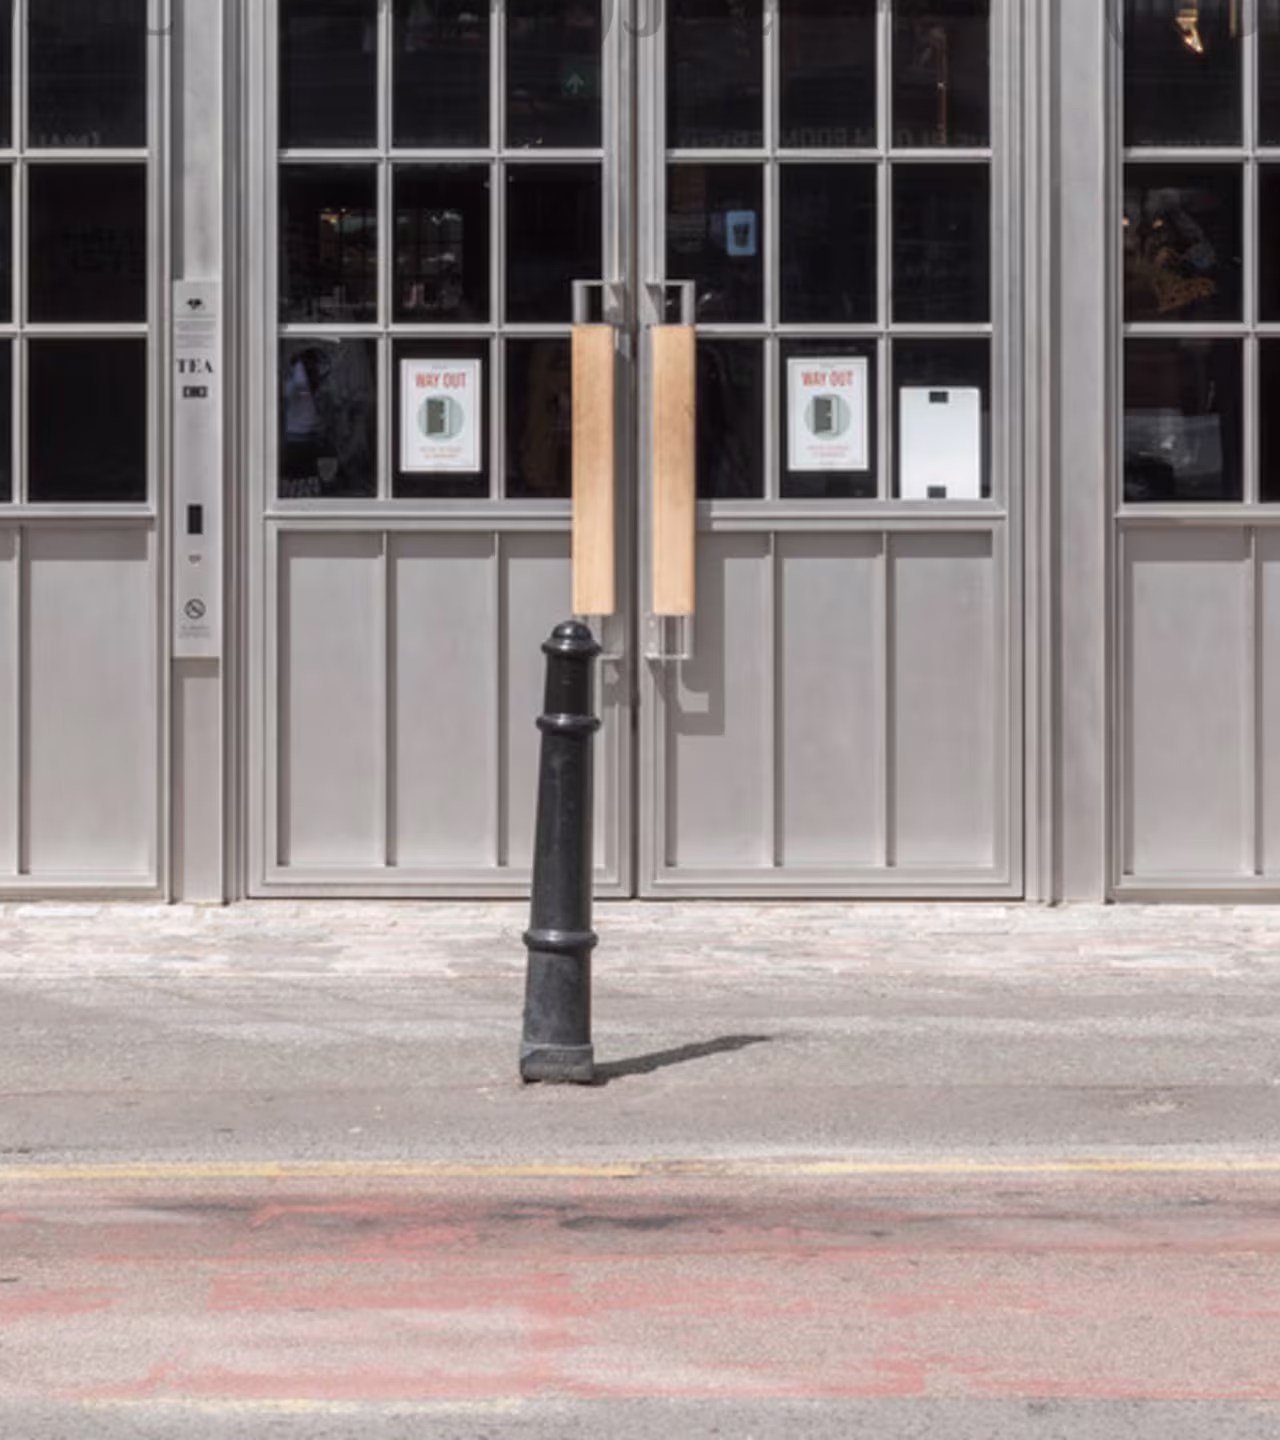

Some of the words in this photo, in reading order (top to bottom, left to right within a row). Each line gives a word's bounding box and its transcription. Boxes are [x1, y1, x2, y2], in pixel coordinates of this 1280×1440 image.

[176, 358, 214, 374] TEA
[416, 373, 441, 388] WAY
[443, 372, 466, 388] OUT
[801, 371, 827, 387] WAY
[830, 370, 854, 387] OUT
